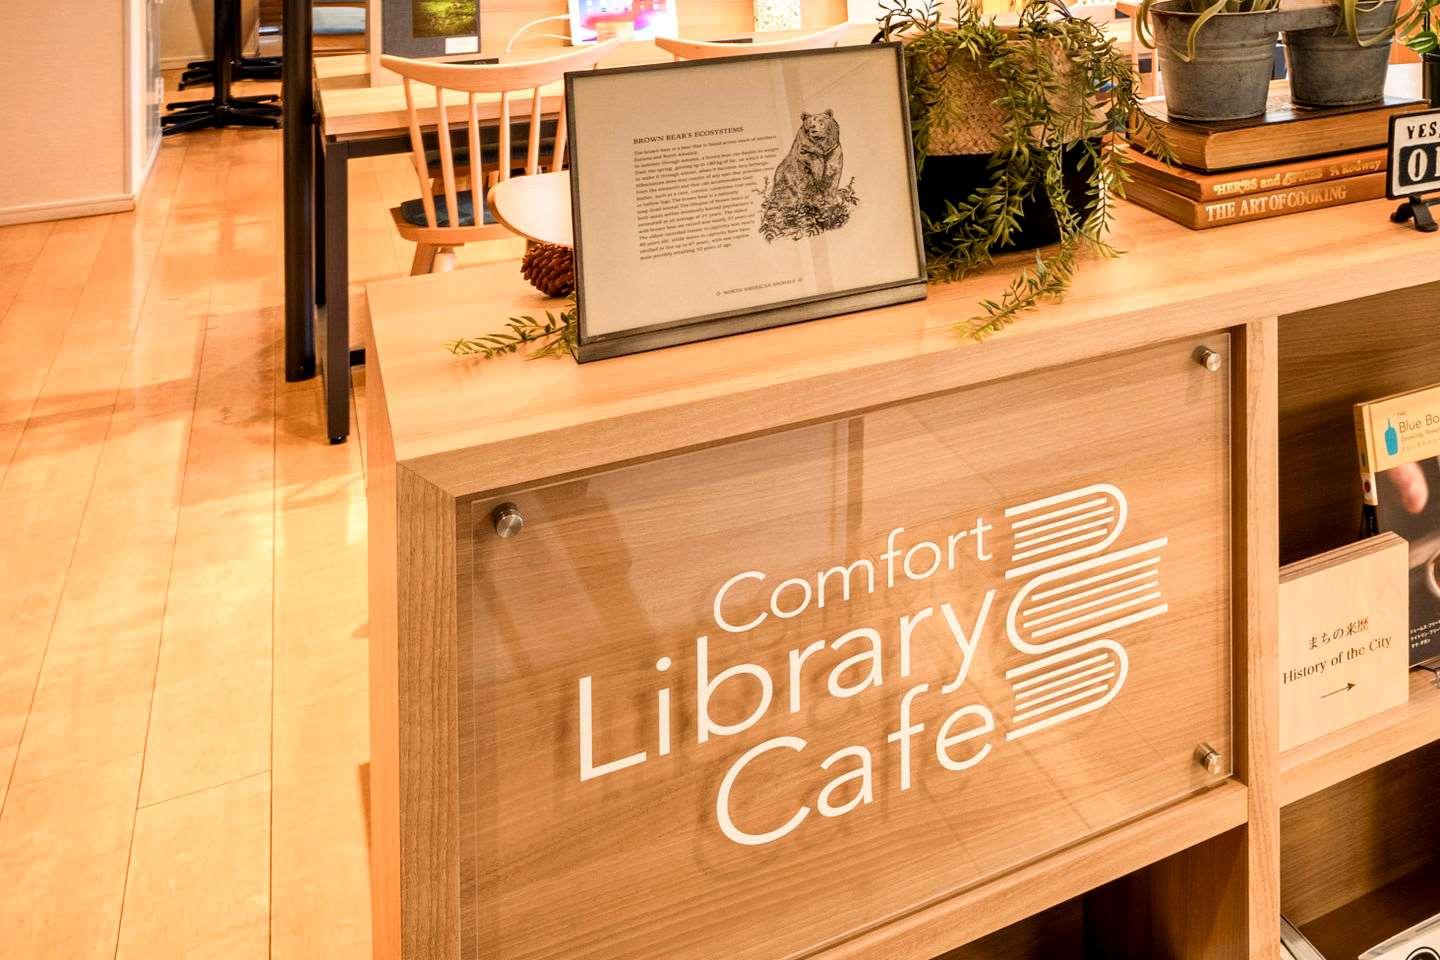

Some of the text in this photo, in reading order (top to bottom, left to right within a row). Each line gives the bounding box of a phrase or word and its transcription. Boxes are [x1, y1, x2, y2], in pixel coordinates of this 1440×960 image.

[633, 135, 664, 145] BROWN
[694, 126, 744, 138] ECOSYSTEMS
[1205, 185, 1347, 222] THE ART OF COOKING
[1213, 178, 1258, 195] HERBS
[1260, 173, 1280, 188] and
[1399, 420, 1422, 434] Blue
[713, 517, 992, 633] Comfort
[1283, 636, 1392, 685] History of the City
[579, 590, 996, 782] Library
[716, 684, 995, 846] Cafe
